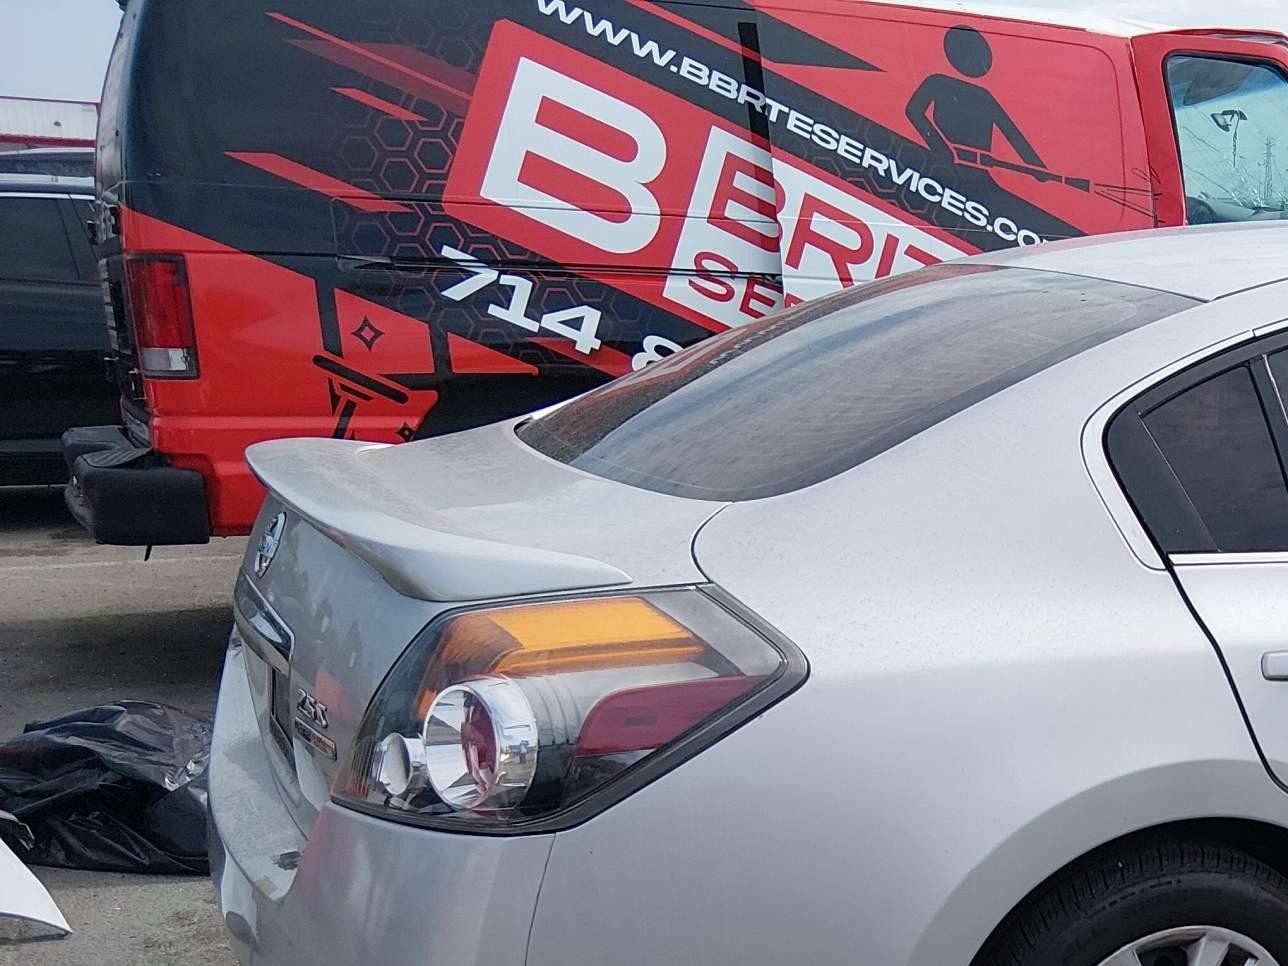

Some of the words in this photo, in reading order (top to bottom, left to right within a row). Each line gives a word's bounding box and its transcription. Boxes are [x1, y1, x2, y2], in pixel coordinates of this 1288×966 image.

[480, 56, 667, 254] B
[440, 245, 602, 355] 714
[688, 250, 807, 319] SE
